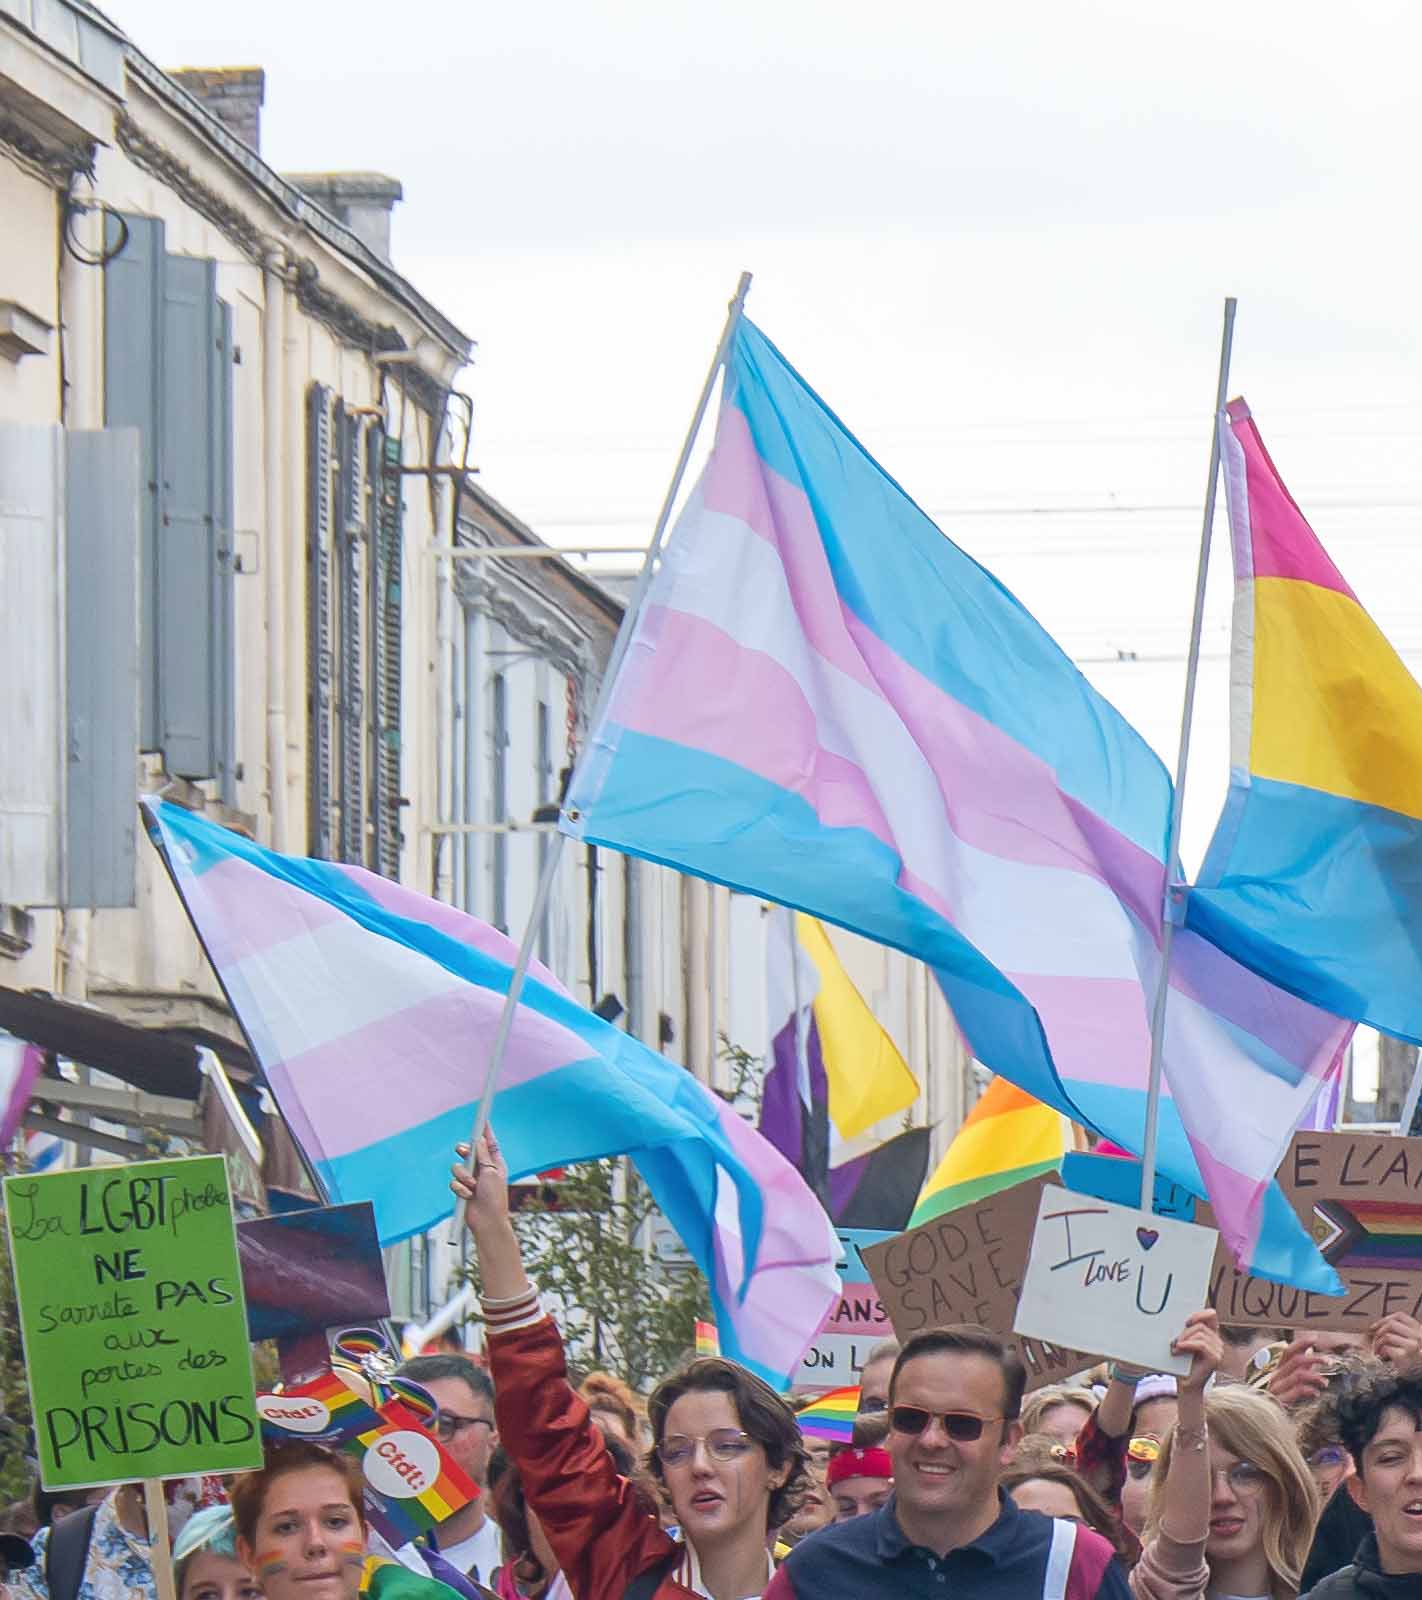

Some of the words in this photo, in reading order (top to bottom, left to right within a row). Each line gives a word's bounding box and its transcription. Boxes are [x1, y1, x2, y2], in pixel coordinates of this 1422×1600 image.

[8, 1183, 71, 1241] La
[94, 1249, 146, 1284] NE
[1043, 1209, 1109, 1272] I
[1084, 1258, 1132, 1287] LOVE
[1135, 1263, 1173, 1315] U
[155, 1278, 233, 1311] PAS
[900, 1247, 1016, 1331] SAVE
[829, 1297, 889, 1324] ANS
[103, 1328, 180, 1351] aux
[81, 1361, 162, 1398] portes
[178, 1349, 228, 1371] des
